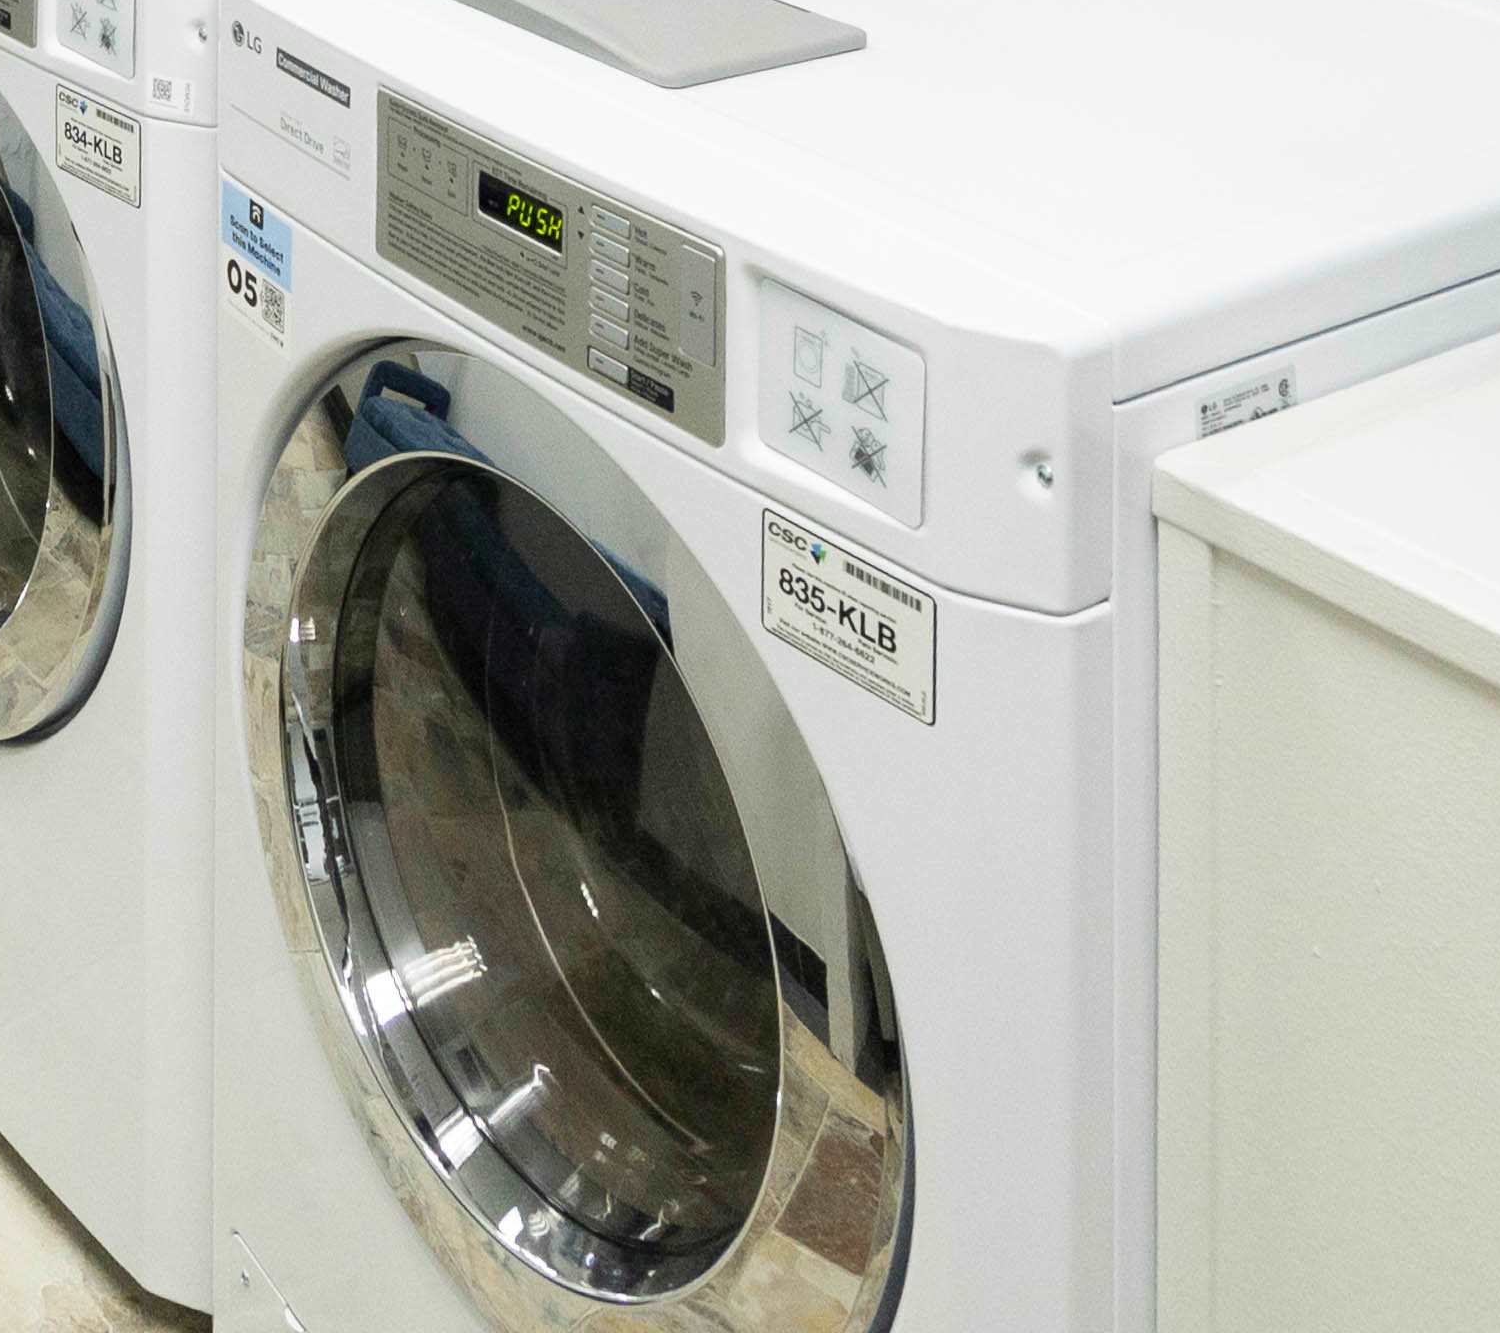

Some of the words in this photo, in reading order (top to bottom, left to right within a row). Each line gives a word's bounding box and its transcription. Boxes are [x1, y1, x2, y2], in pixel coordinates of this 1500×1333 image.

[247, 31, 261, 55] LG
[278, 51, 318, 87] Commercial
[319, 75, 348, 104] Washer
[64, 120, 122, 165] 834-KLB
[507, 190, 562, 246] PUSH
[227, 259, 258, 307] 05
[768, 519, 807, 553] CSC
[779, 565, 897, 656] 835-KLB
